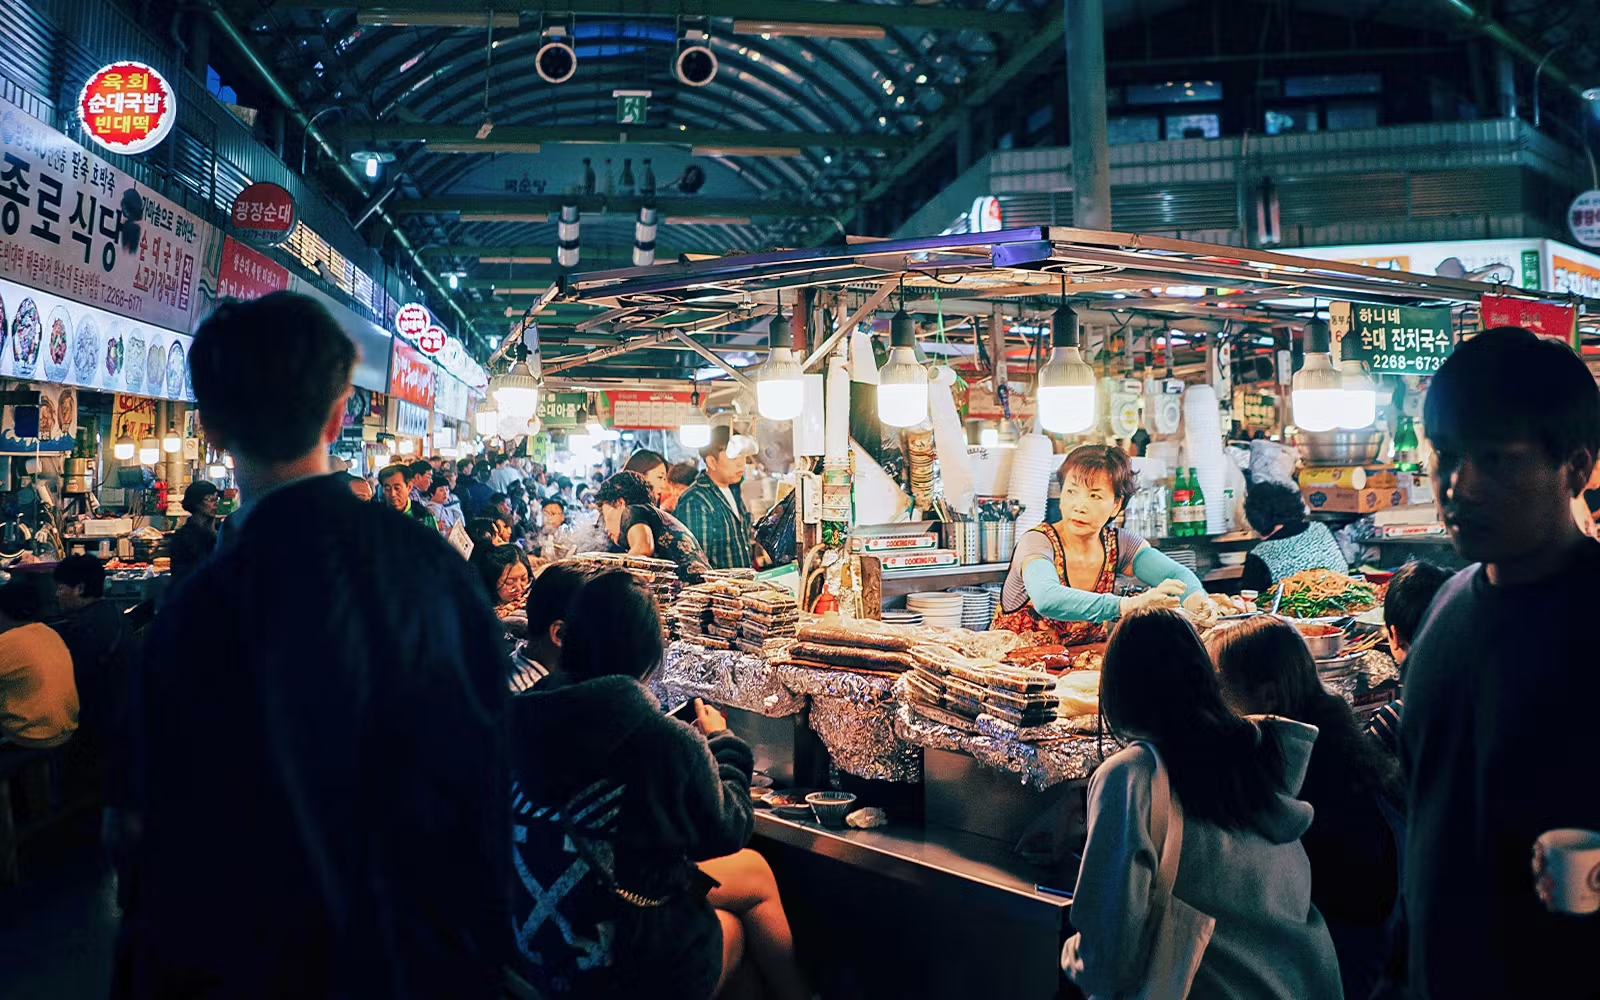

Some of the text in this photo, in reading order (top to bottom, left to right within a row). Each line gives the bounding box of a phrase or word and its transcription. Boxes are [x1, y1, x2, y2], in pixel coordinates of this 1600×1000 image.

[101, 73, 149, 90] 육회
[87, 92, 161, 114] 순대국밥
[95, 115, 150, 134] 빈대떡
[90, 162, 115, 198] 호박죽
[0, 151, 123, 273] 종로식당
[141, 195, 174, 231] 가마솥으로
[235, 201, 292, 223] 광장순대
[1359, 308, 1400, 325] 하니네
[1361, 326, 1450, 353] 순대 잔치국수
